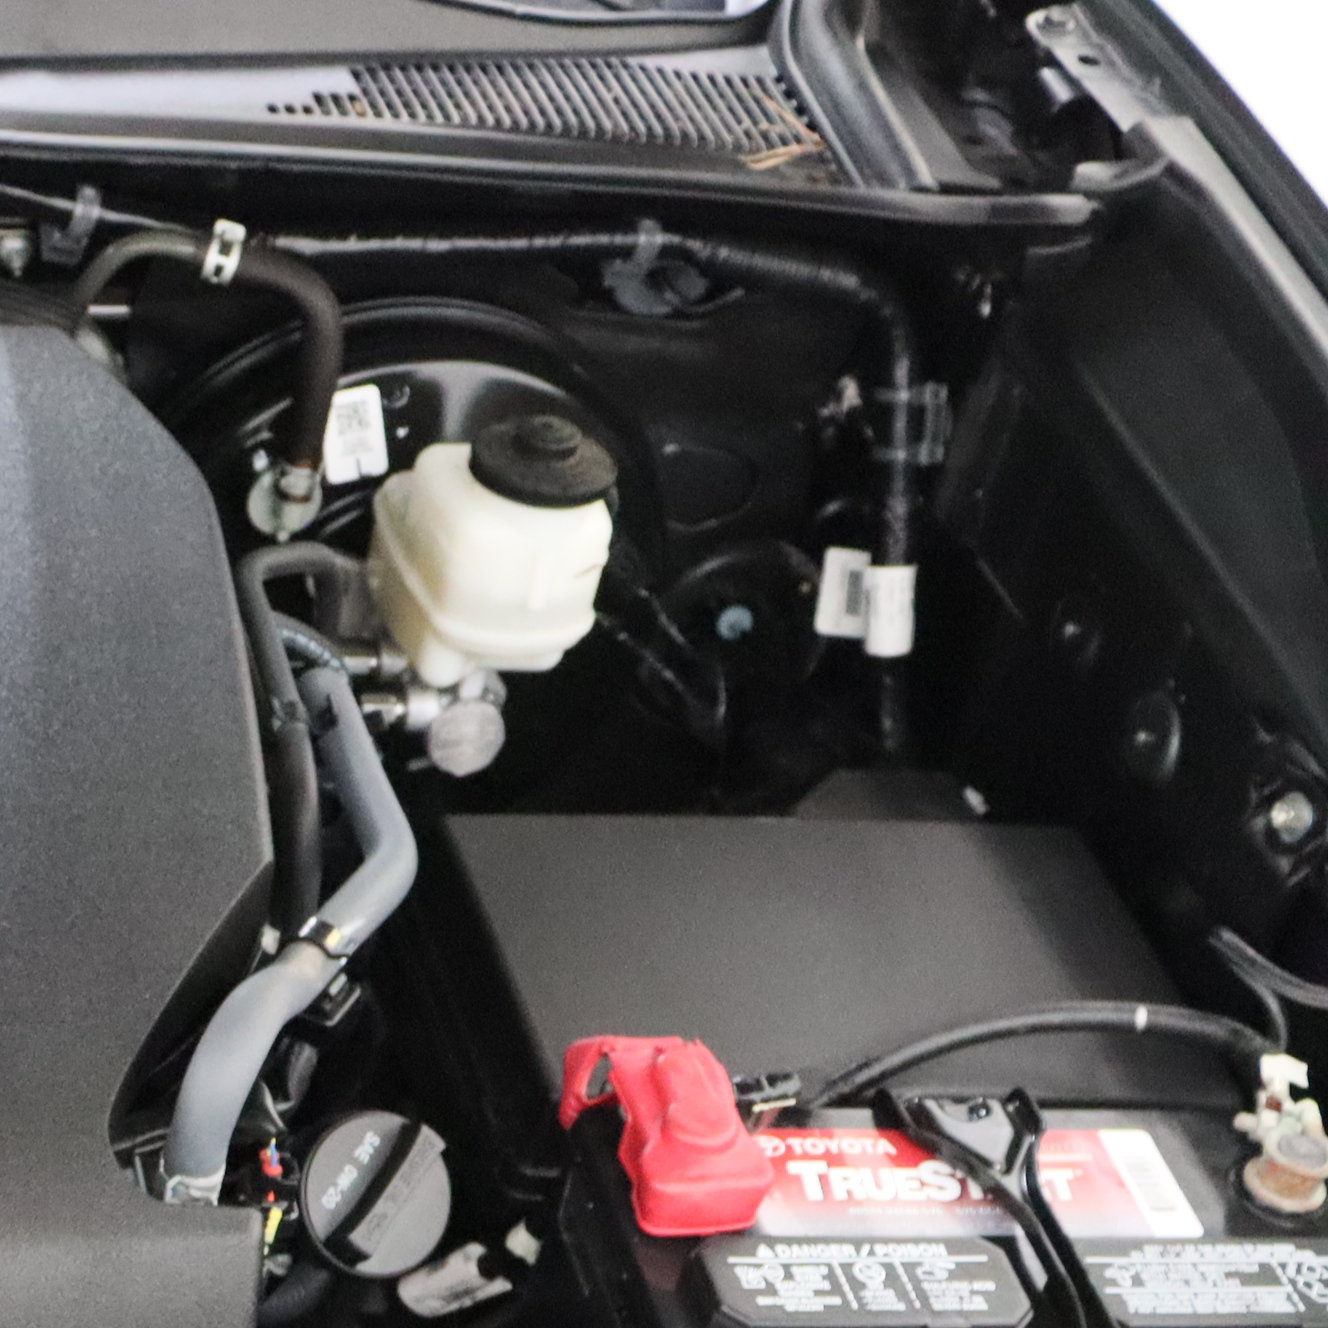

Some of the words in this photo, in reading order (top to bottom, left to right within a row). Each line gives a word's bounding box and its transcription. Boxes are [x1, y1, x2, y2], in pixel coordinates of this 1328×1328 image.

[353, 1131, 381, 1164] SAE
[787, 1137, 897, 1157] TOYOTA
[321, 1164, 359, 1210] 0W-20
[775, 1243, 856, 1258] DANGER
